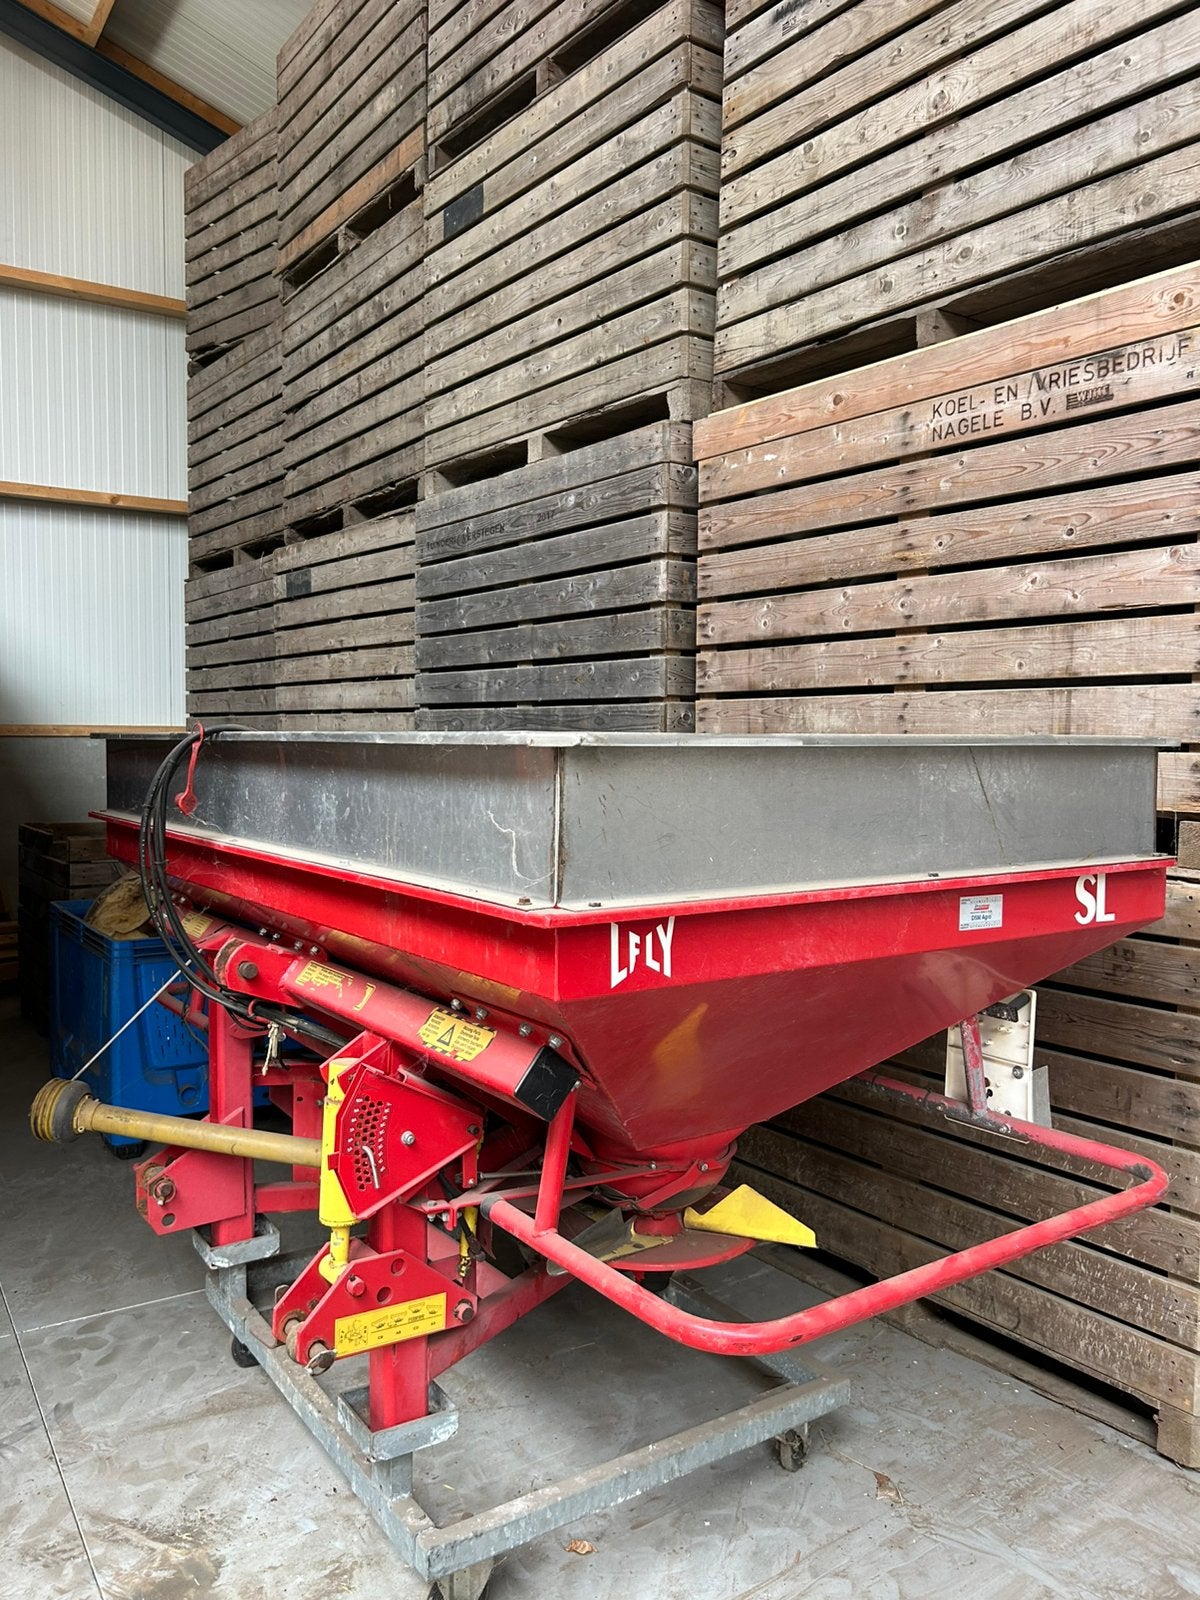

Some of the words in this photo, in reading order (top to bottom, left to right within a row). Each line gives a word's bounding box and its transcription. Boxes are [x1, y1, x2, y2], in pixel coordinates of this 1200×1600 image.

[931, 410, 1005, 442] NAGELE
[1021, 397, 1056, 421] B.V.
[932, 393, 986, 420] KOEL-
[994, 383, 1019, 404] EN
[1073, 873, 1116, 925] SL
